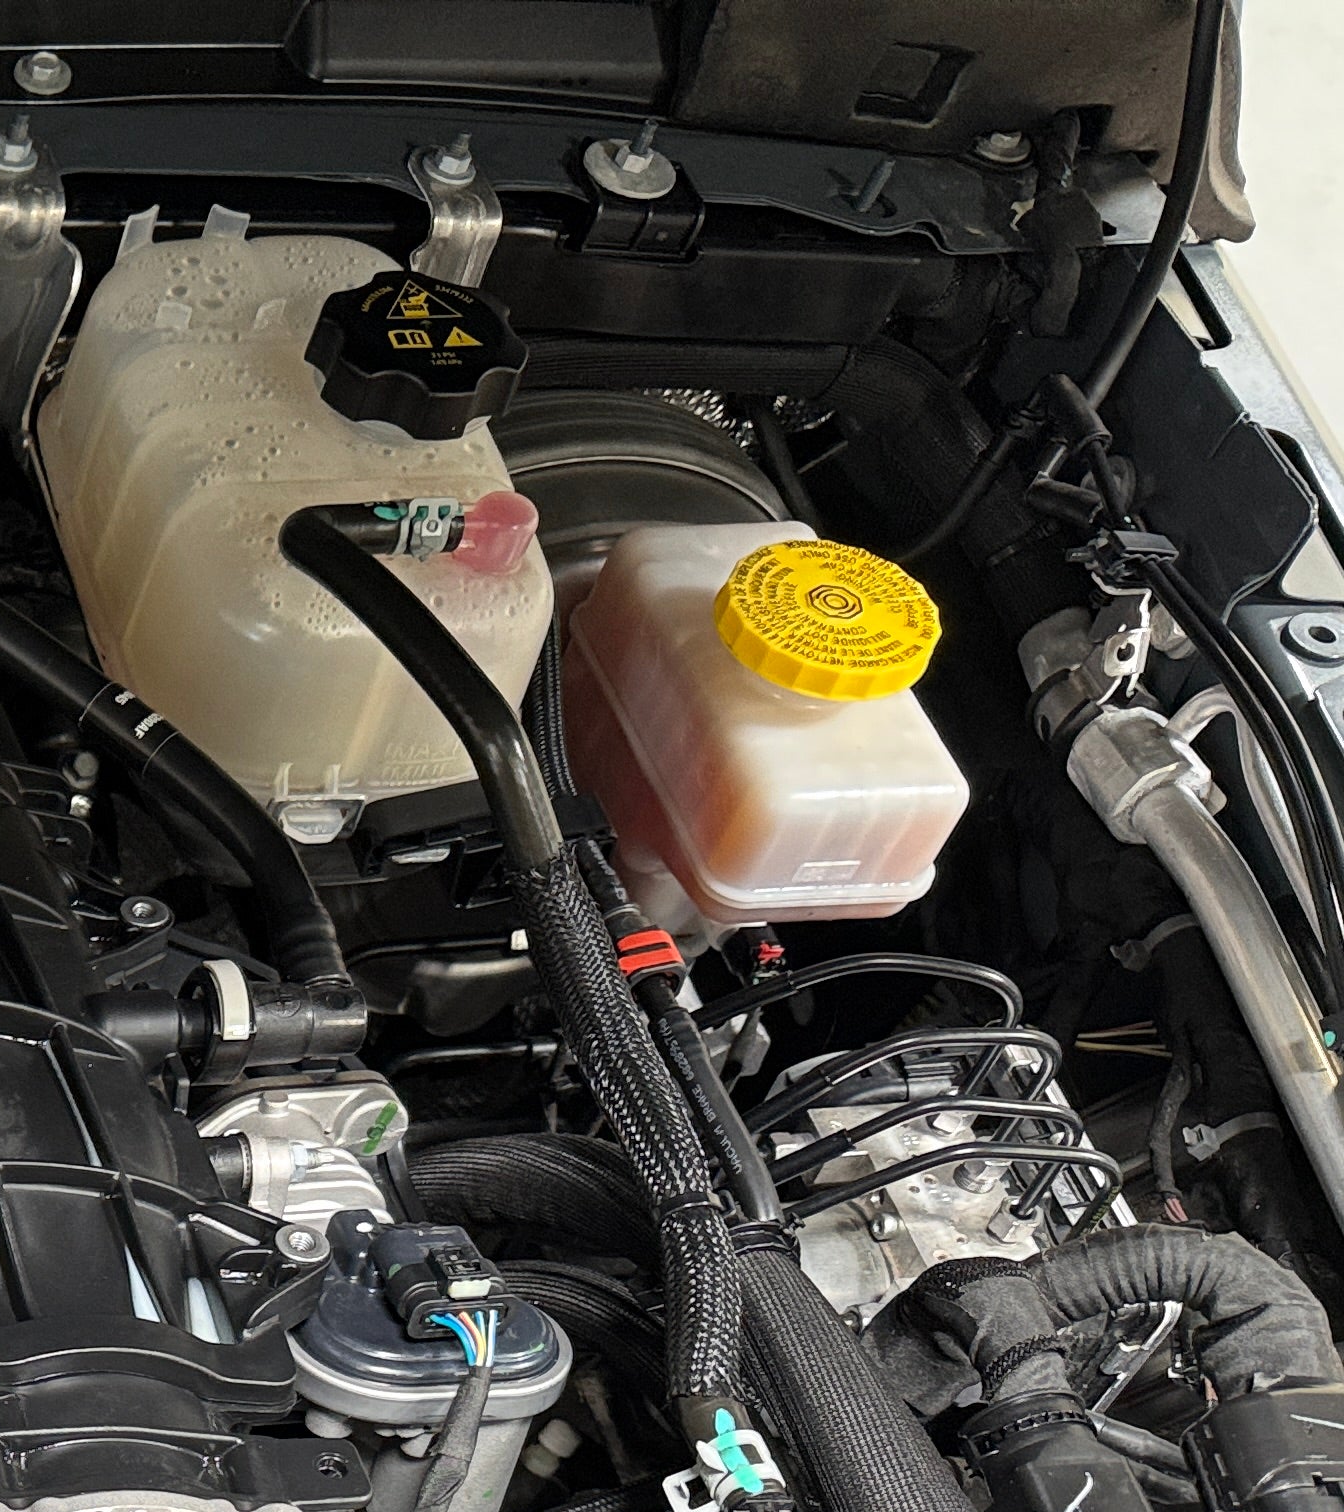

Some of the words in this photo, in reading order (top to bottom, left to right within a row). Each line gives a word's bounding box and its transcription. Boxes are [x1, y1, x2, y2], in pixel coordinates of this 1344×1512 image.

[804, 629, 828, 642] DOT
[847, 658, 888, 668] GARDE
[691, 1083, 717, 1124] BRAKE
